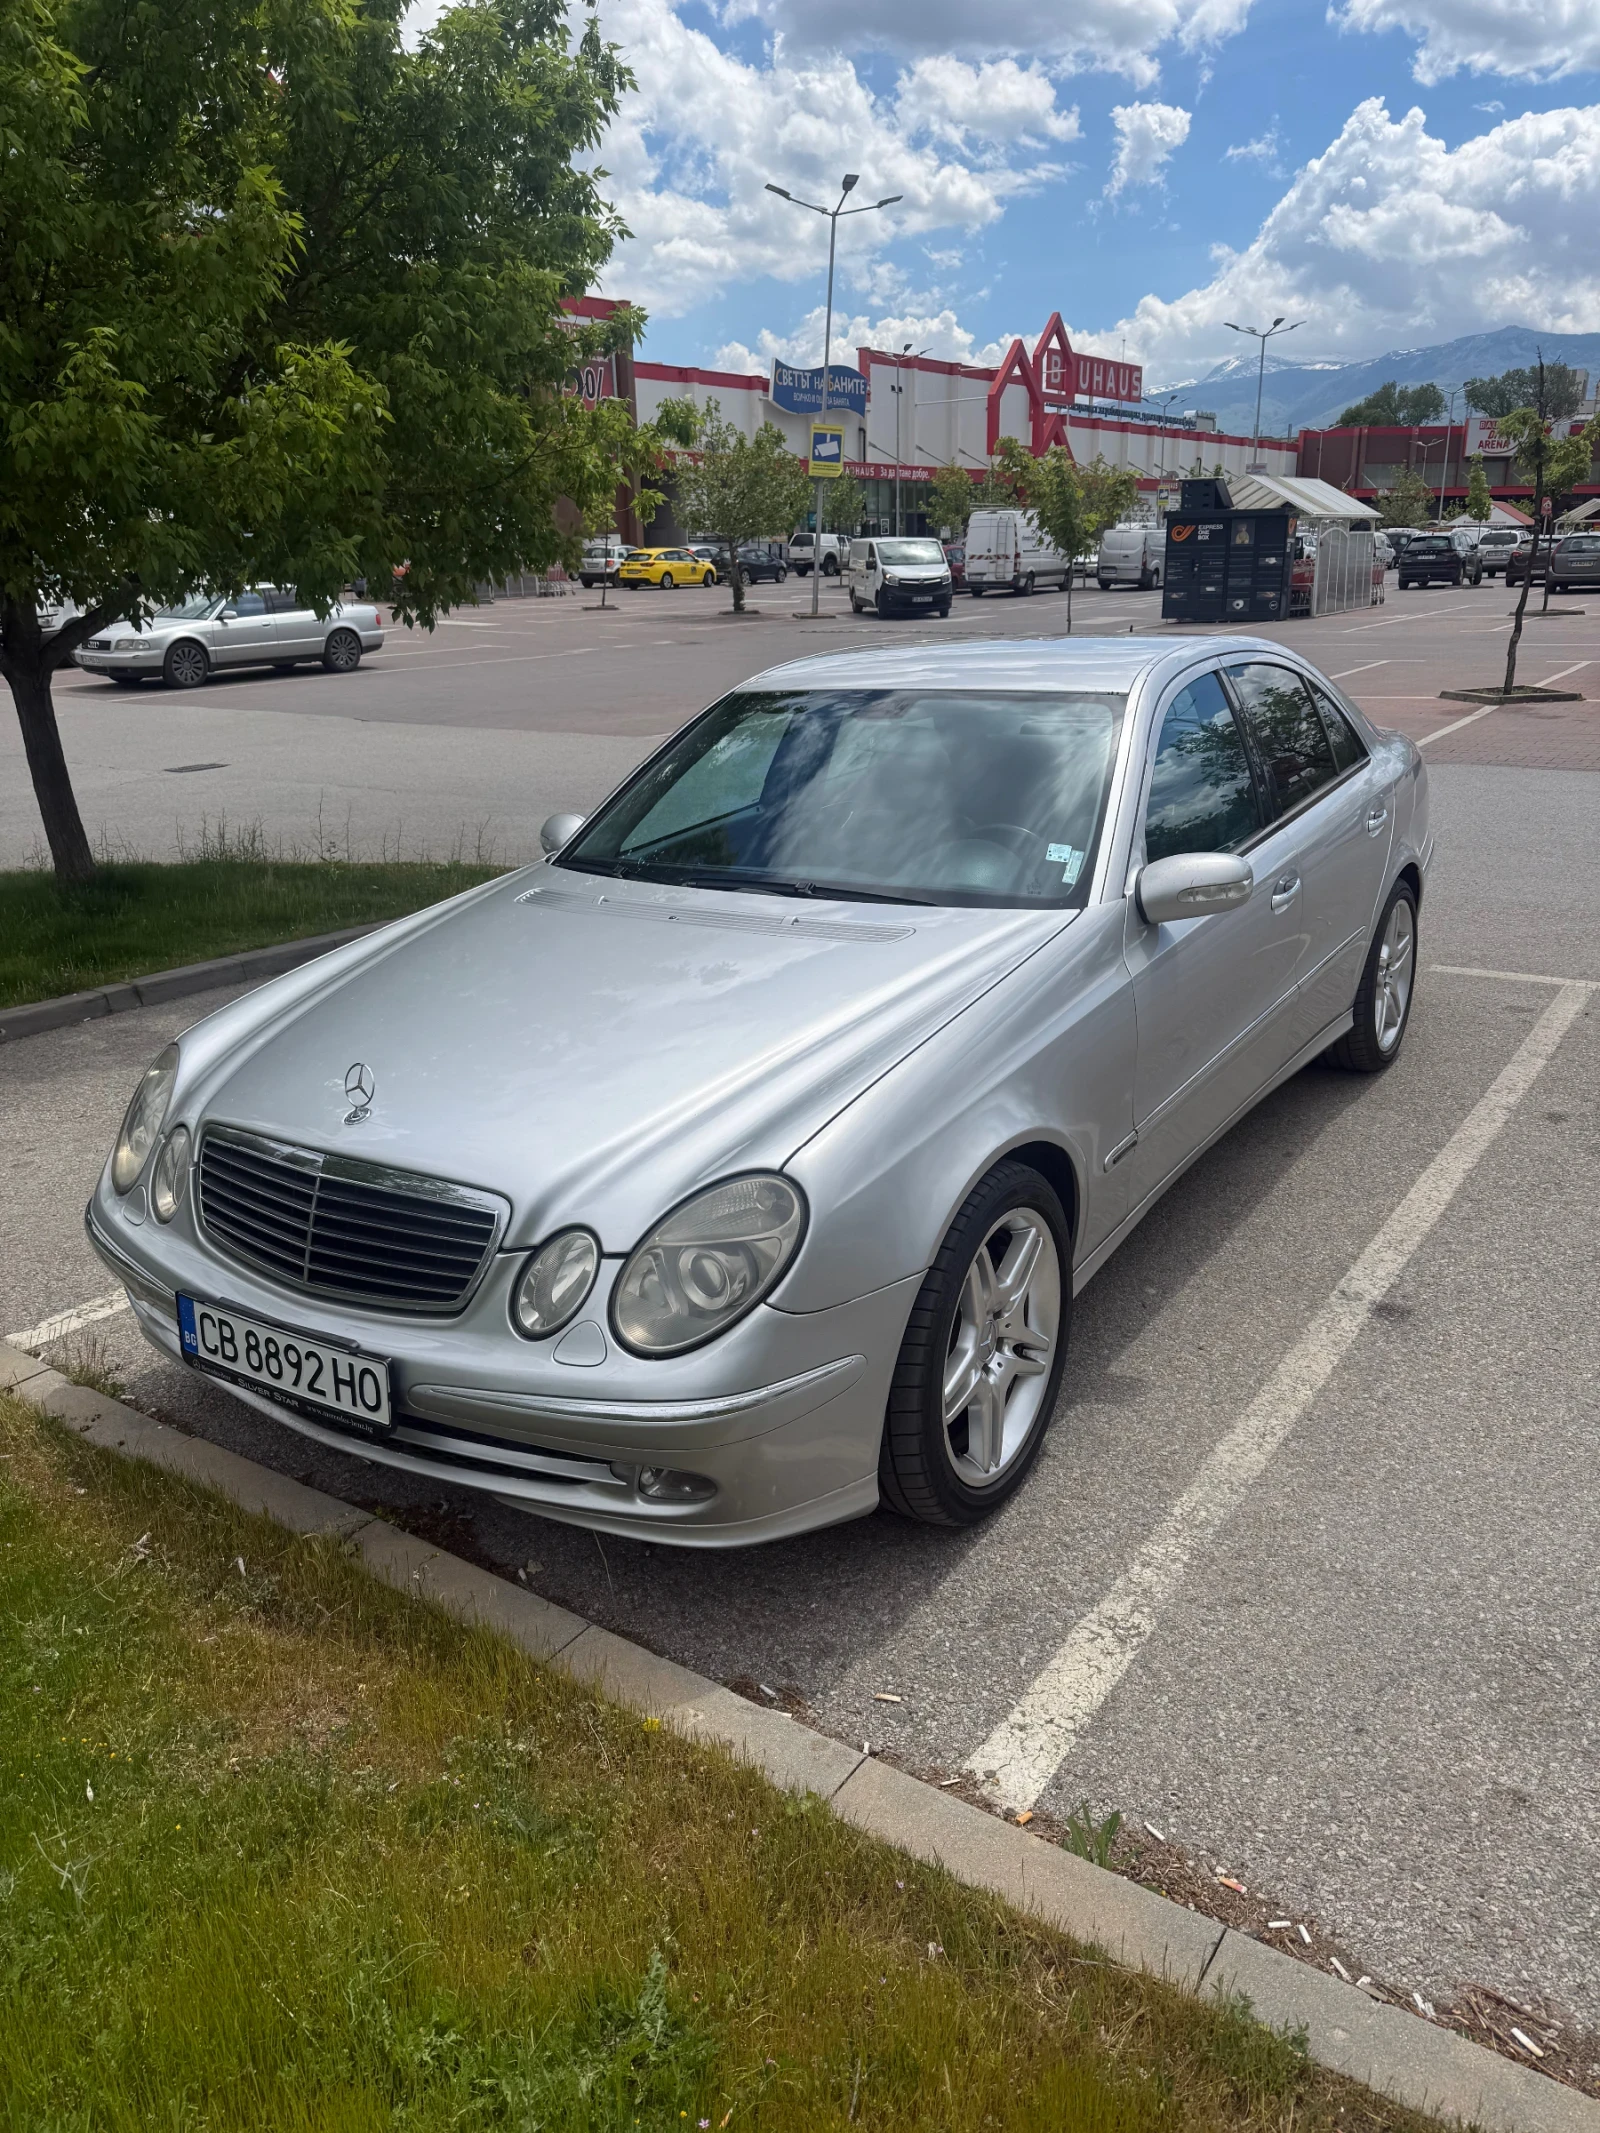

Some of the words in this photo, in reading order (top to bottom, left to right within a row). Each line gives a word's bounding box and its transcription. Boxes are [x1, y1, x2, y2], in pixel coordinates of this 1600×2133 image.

[775, 367, 812, 389] СВЕТЪТ
[828, 374, 866, 395] БАНИТЕ
[1051, 354, 1141, 397] BUHAUS
[1477, 440, 1511, 450] ARENA
[880, 466, 888, 477] За
[887, 469, 896, 479] да
[897, 469, 912, 479] тане
[184, 1330, 198, 1347] BG
[199, 1311, 239, 1363] CB
[244, 1329, 327, 1397] 8892
